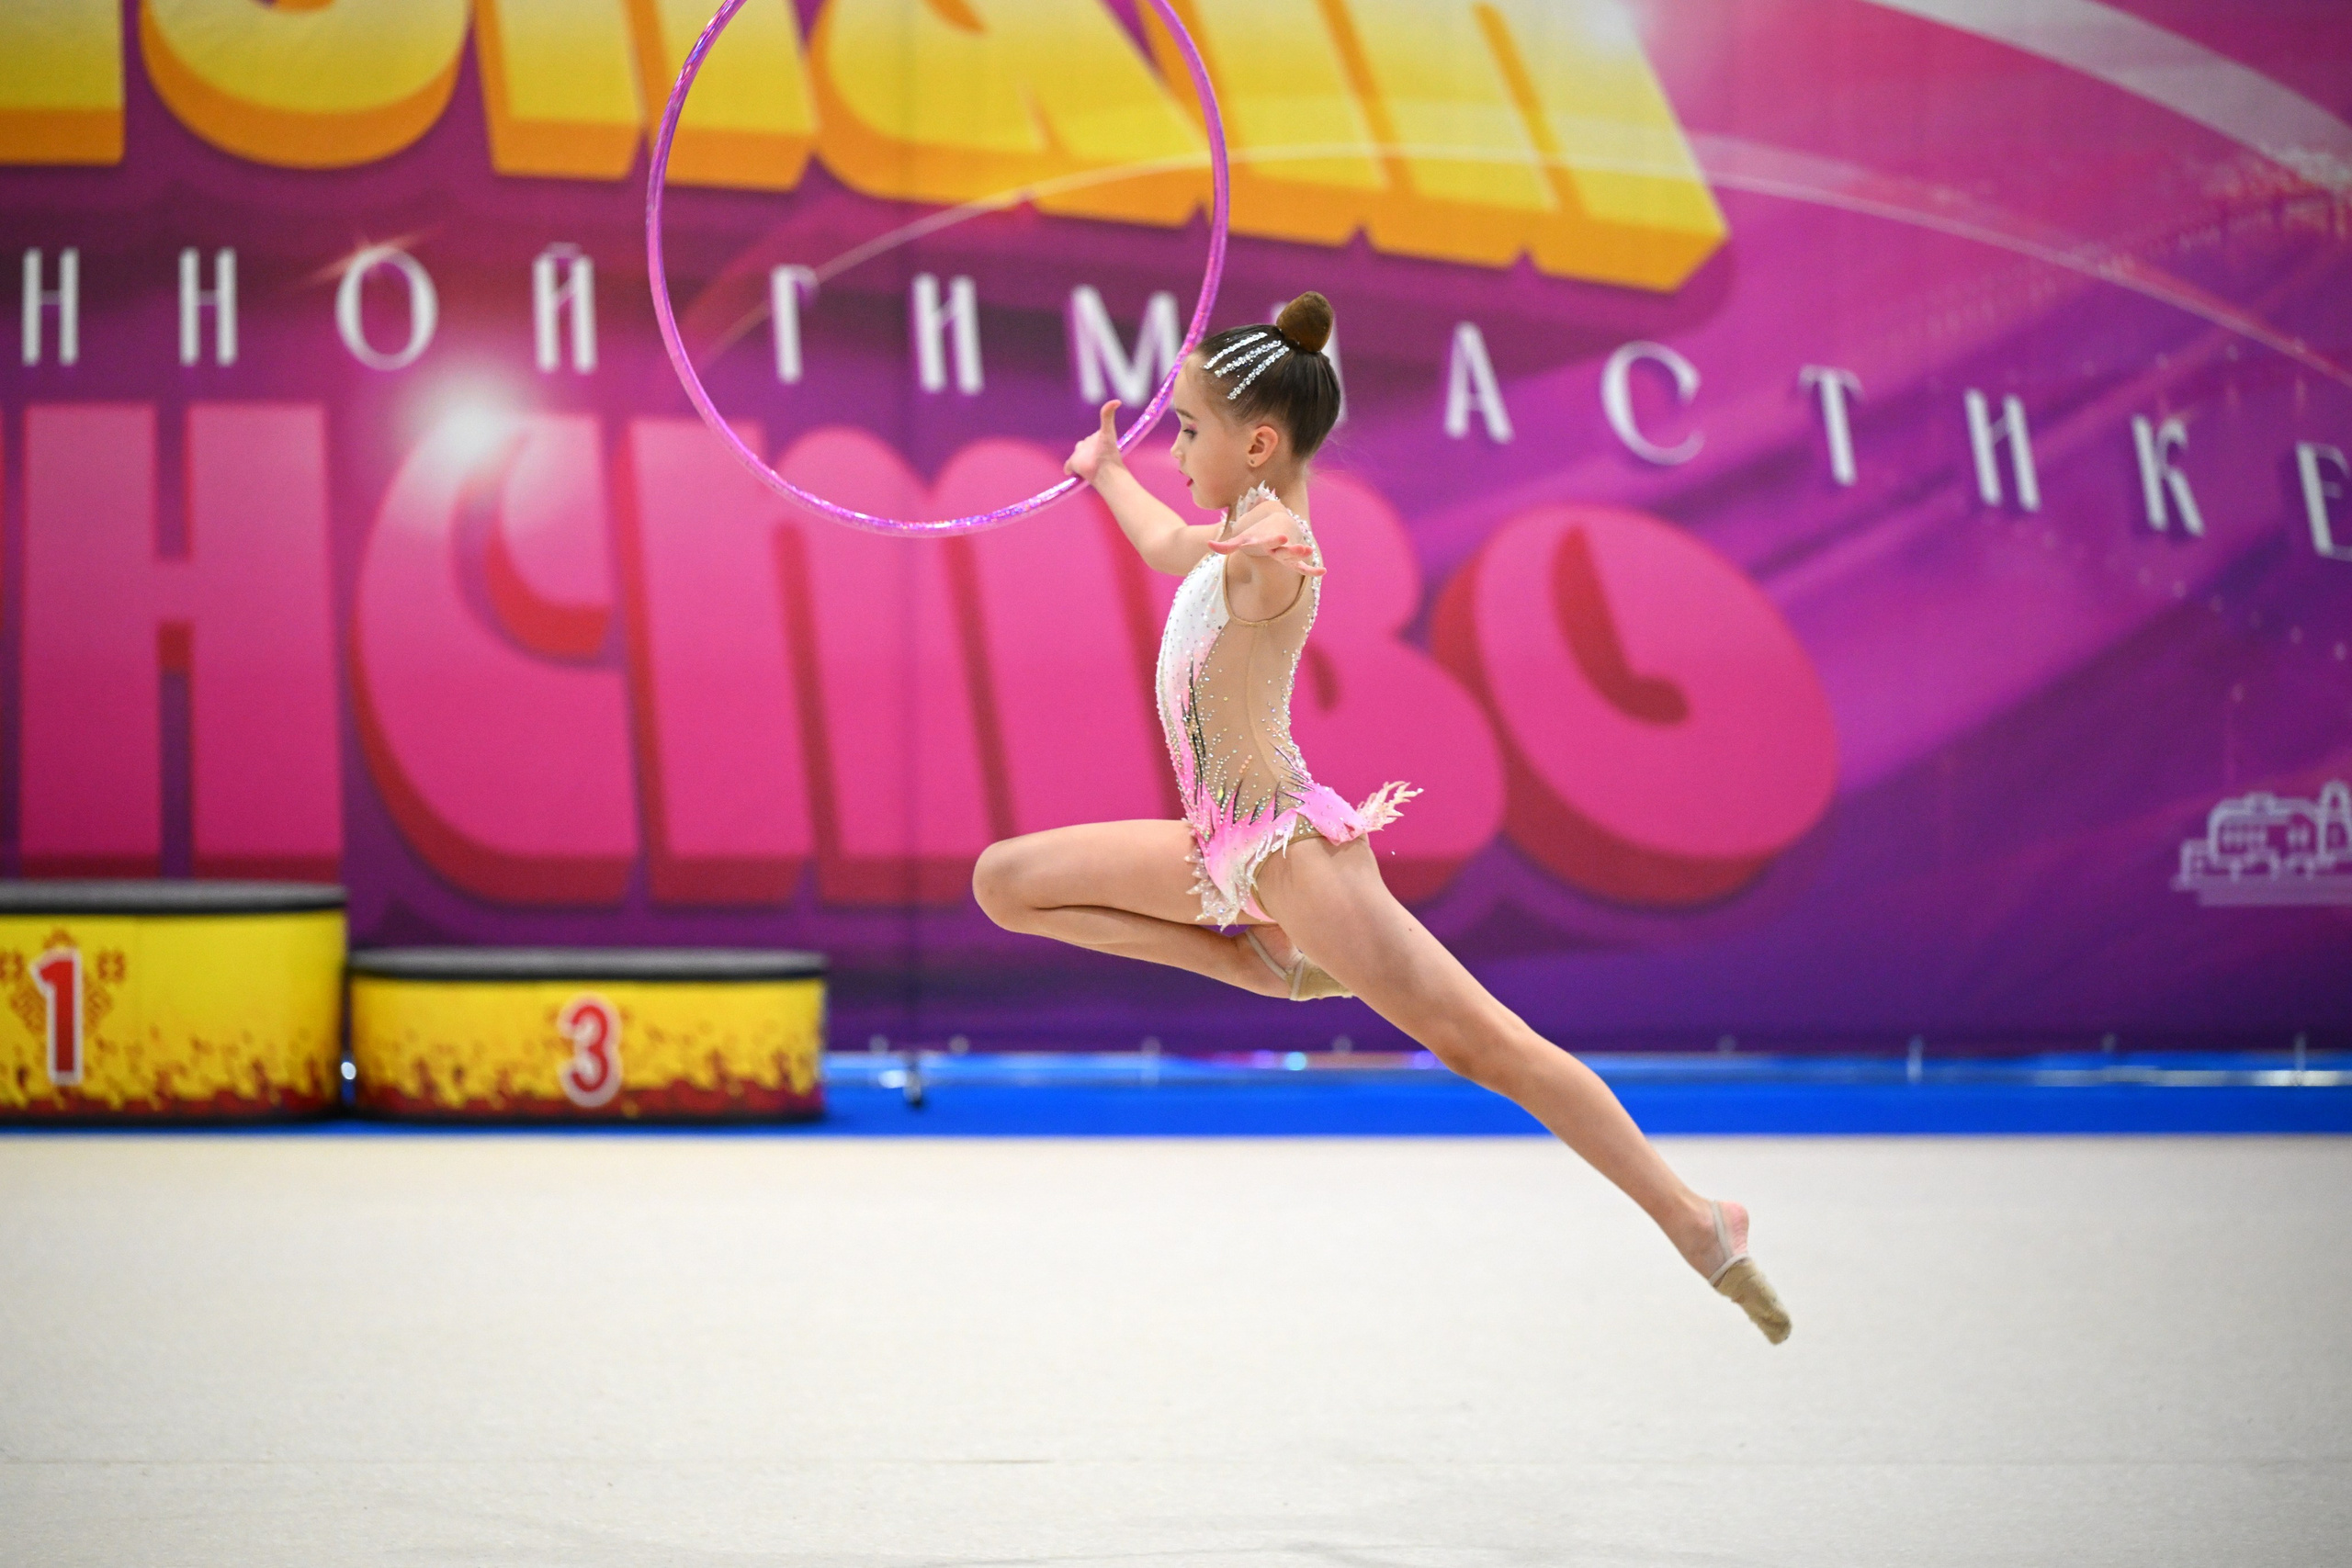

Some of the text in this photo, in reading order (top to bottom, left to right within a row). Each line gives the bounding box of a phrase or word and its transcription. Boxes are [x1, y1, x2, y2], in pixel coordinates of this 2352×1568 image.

[22, 242, 2352, 562] ННОЙ ГИМАСТИКЕ
[31, 949, 85, 1084] 1
[560, 996, 621, 1106] 3
